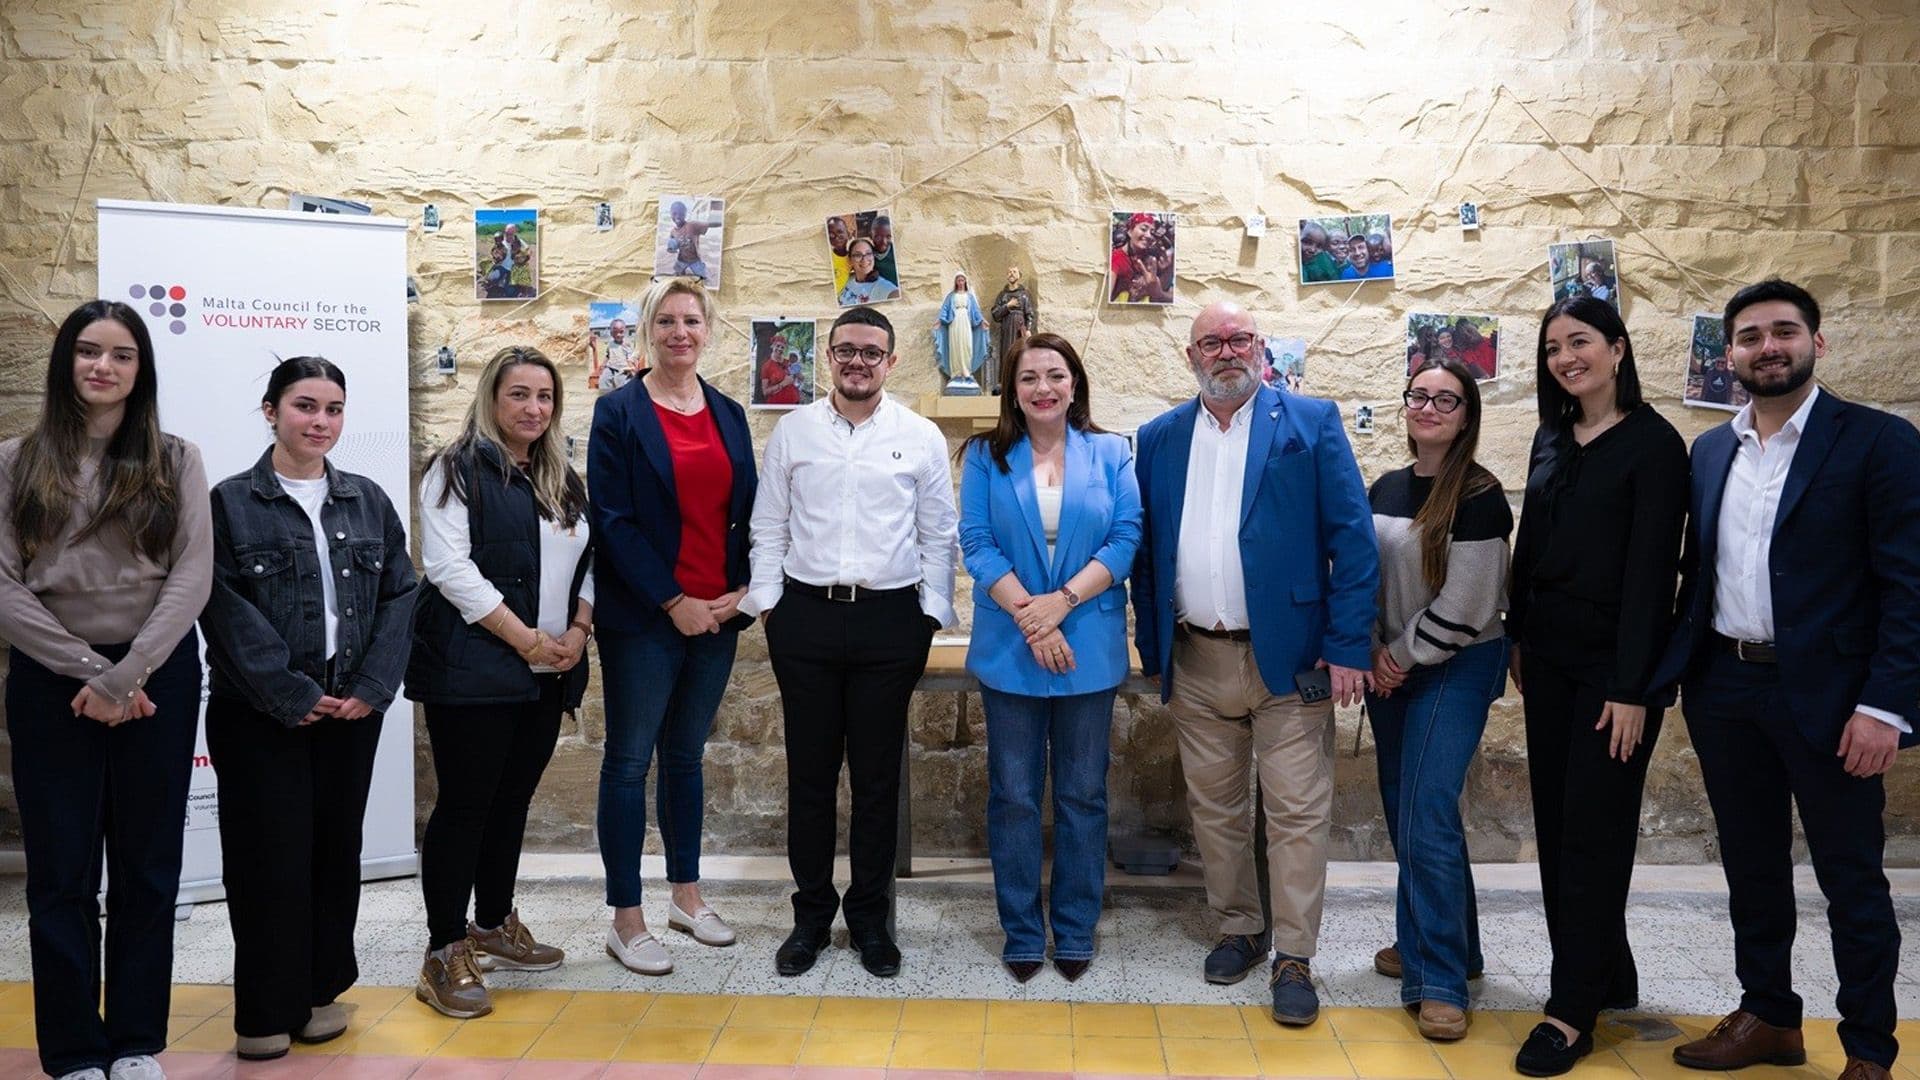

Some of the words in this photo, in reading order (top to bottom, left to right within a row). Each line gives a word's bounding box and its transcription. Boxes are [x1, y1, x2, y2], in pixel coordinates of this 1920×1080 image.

[203, 297, 246, 310] Malta
[251, 299, 310, 313] Council
[317, 300, 338, 315] for
[344, 303, 368, 316] the
[203, 314, 308, 330] VOLUNTARY
[314, 318, 381, 333] SECTOR
